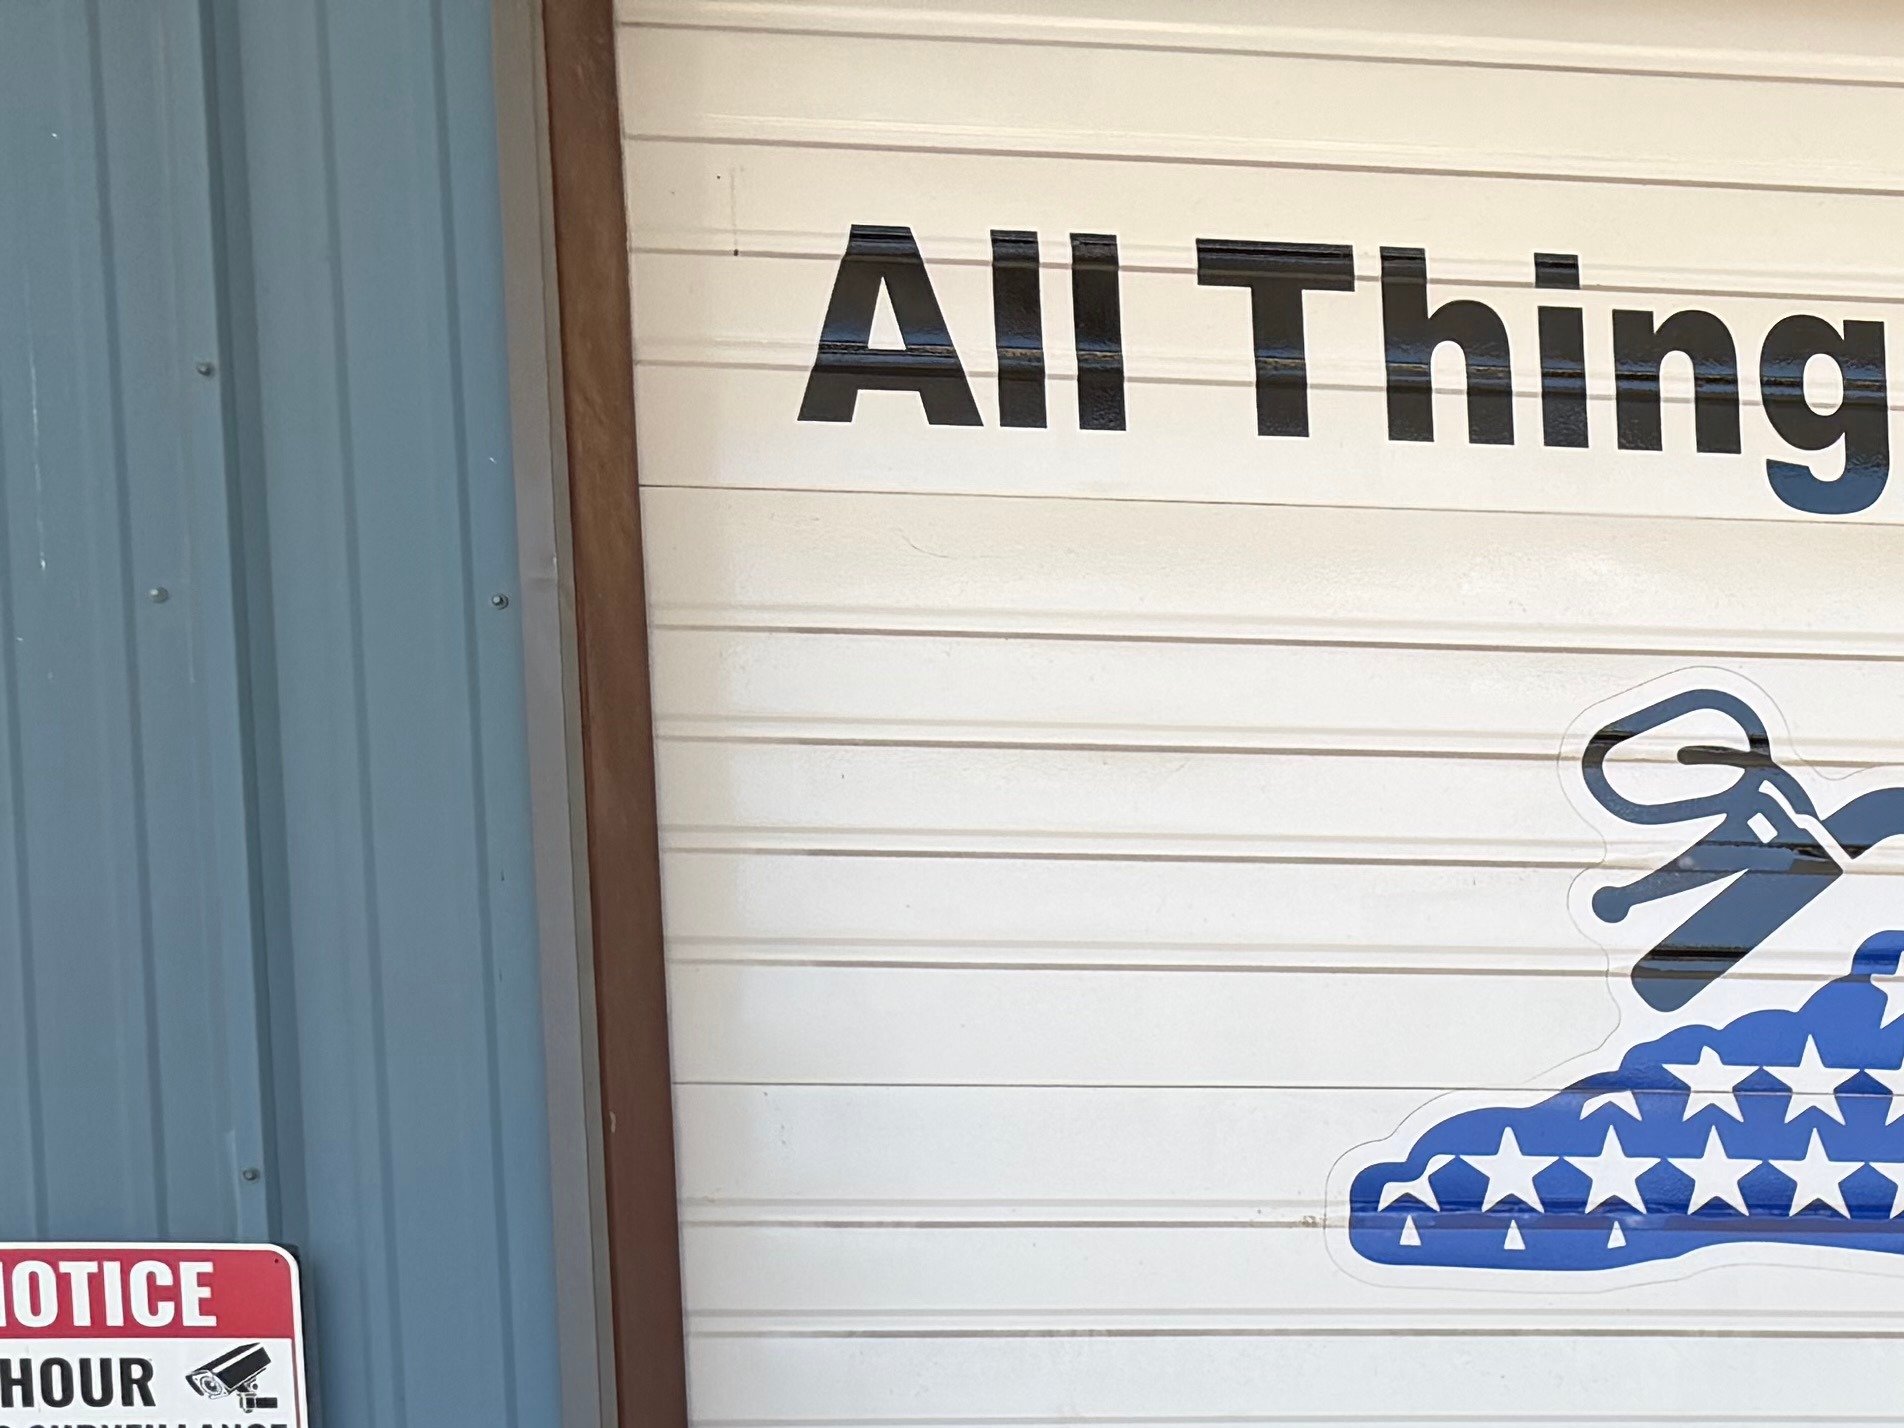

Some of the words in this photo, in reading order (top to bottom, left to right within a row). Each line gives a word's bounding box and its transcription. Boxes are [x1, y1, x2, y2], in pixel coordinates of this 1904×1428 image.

[795, 222, 1128, 433] All
[0, 1260, 217, 1328] OTICE
[0, 1357, 156, 1409] HOUR
